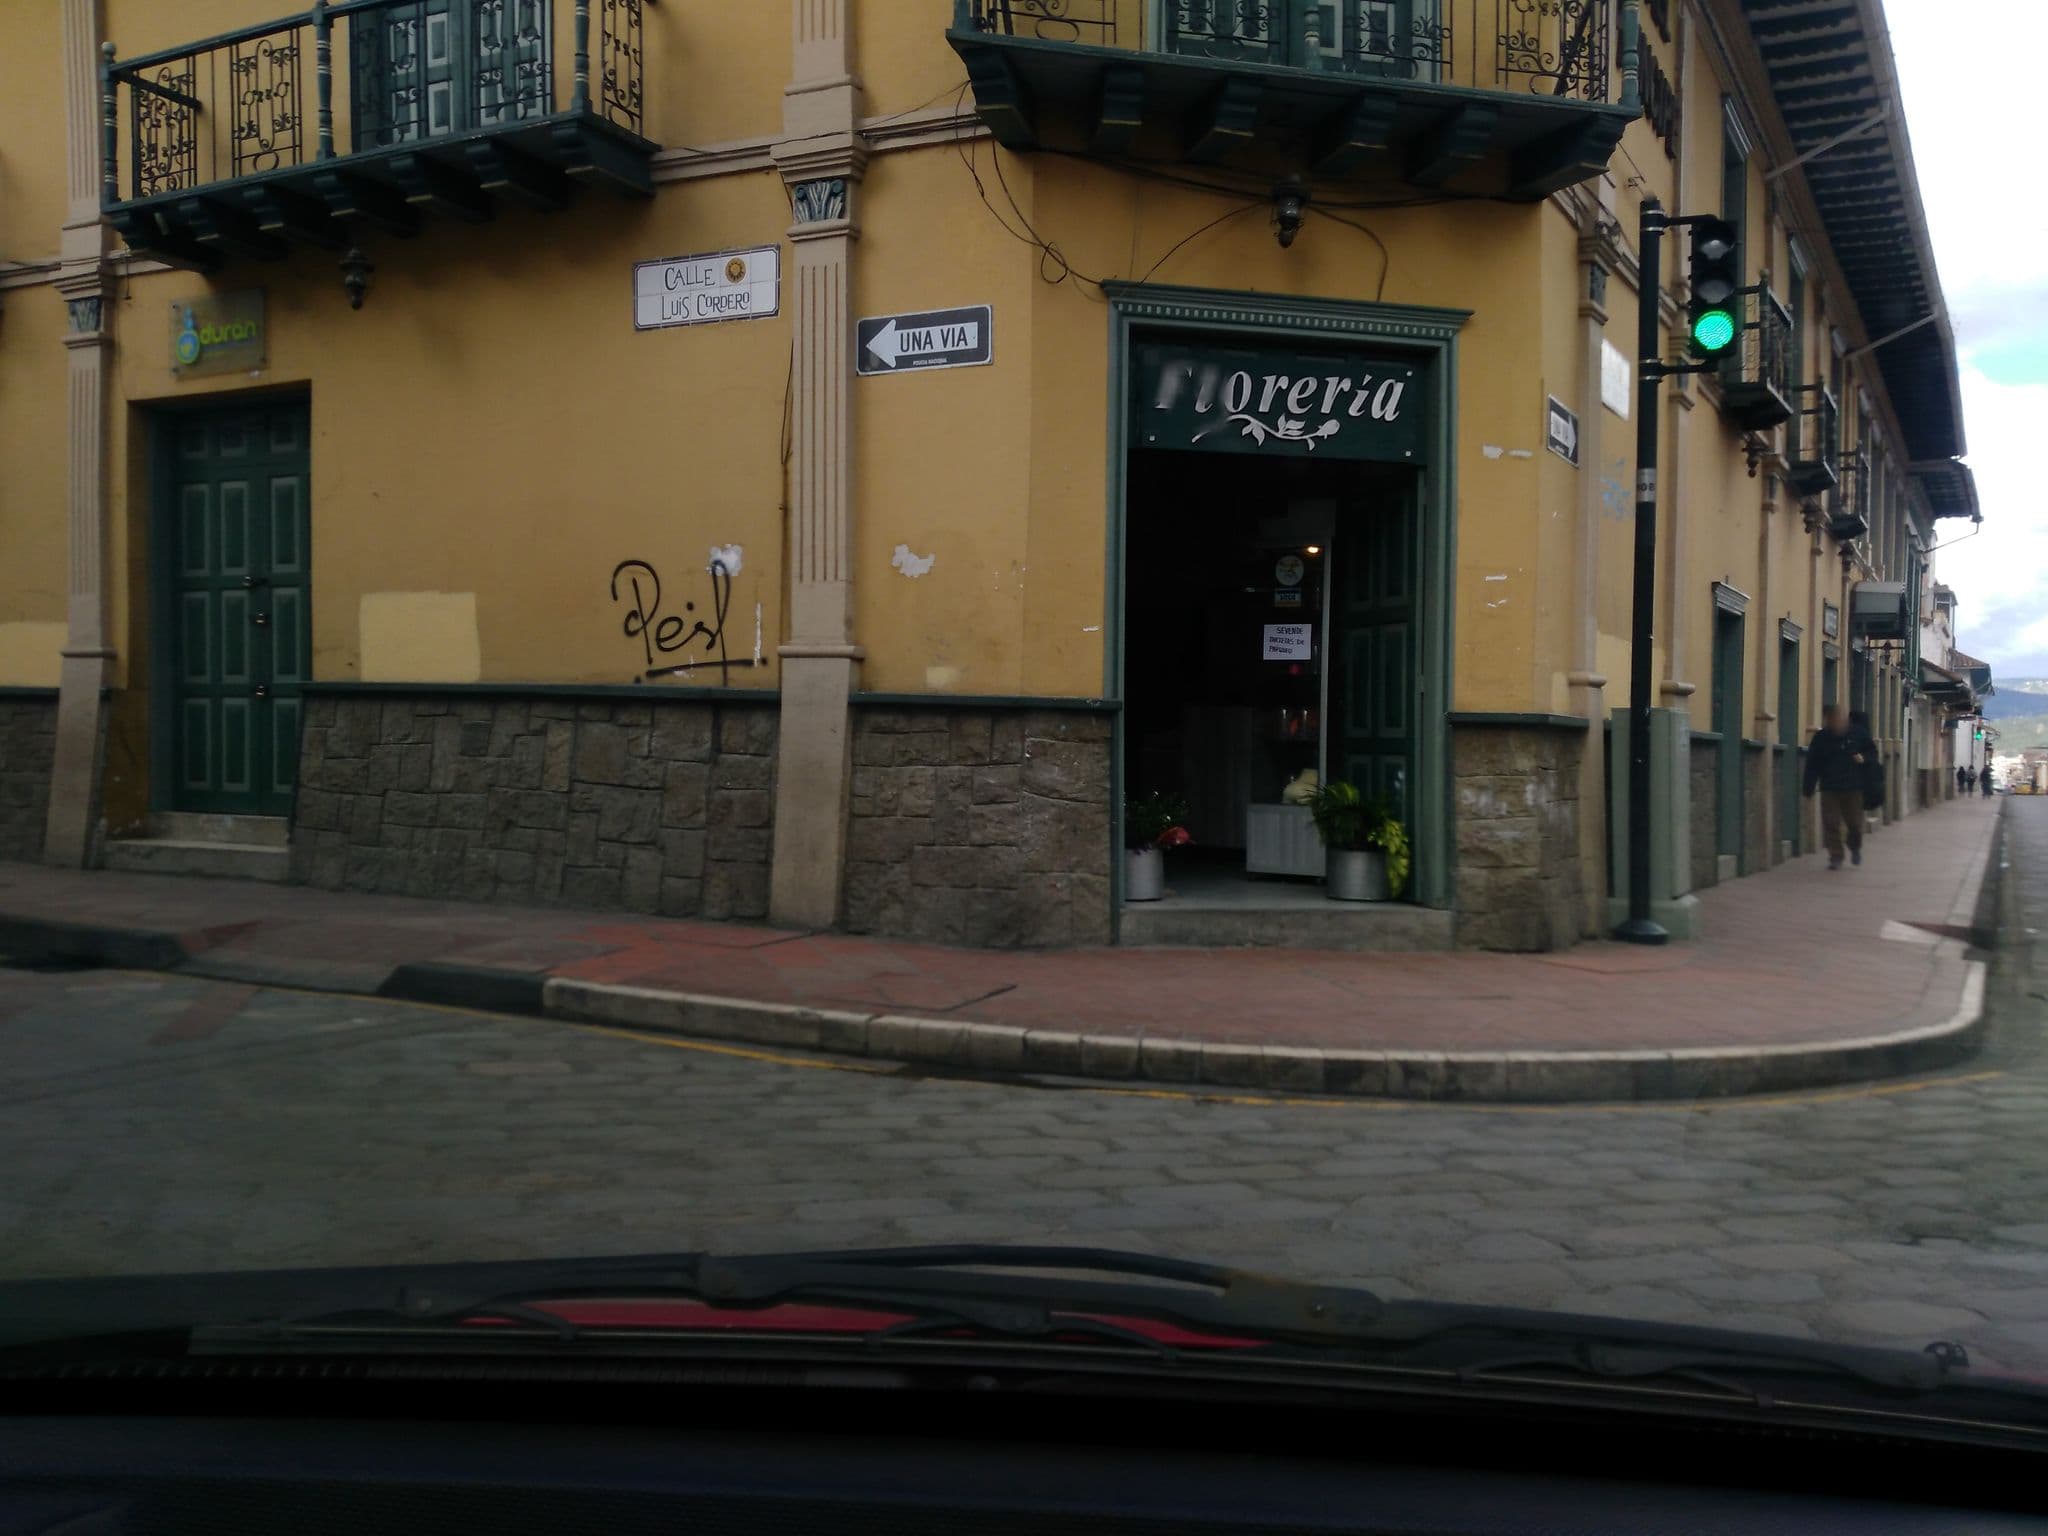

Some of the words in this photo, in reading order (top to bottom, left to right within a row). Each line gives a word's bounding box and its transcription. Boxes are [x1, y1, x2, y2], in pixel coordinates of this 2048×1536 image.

[665, 265, 715, 290] CALLE
[697, 292, 750, 316] CORDERO
[900, 330, 934, 353] UNA
[940, 326, 968, 349] VIA
